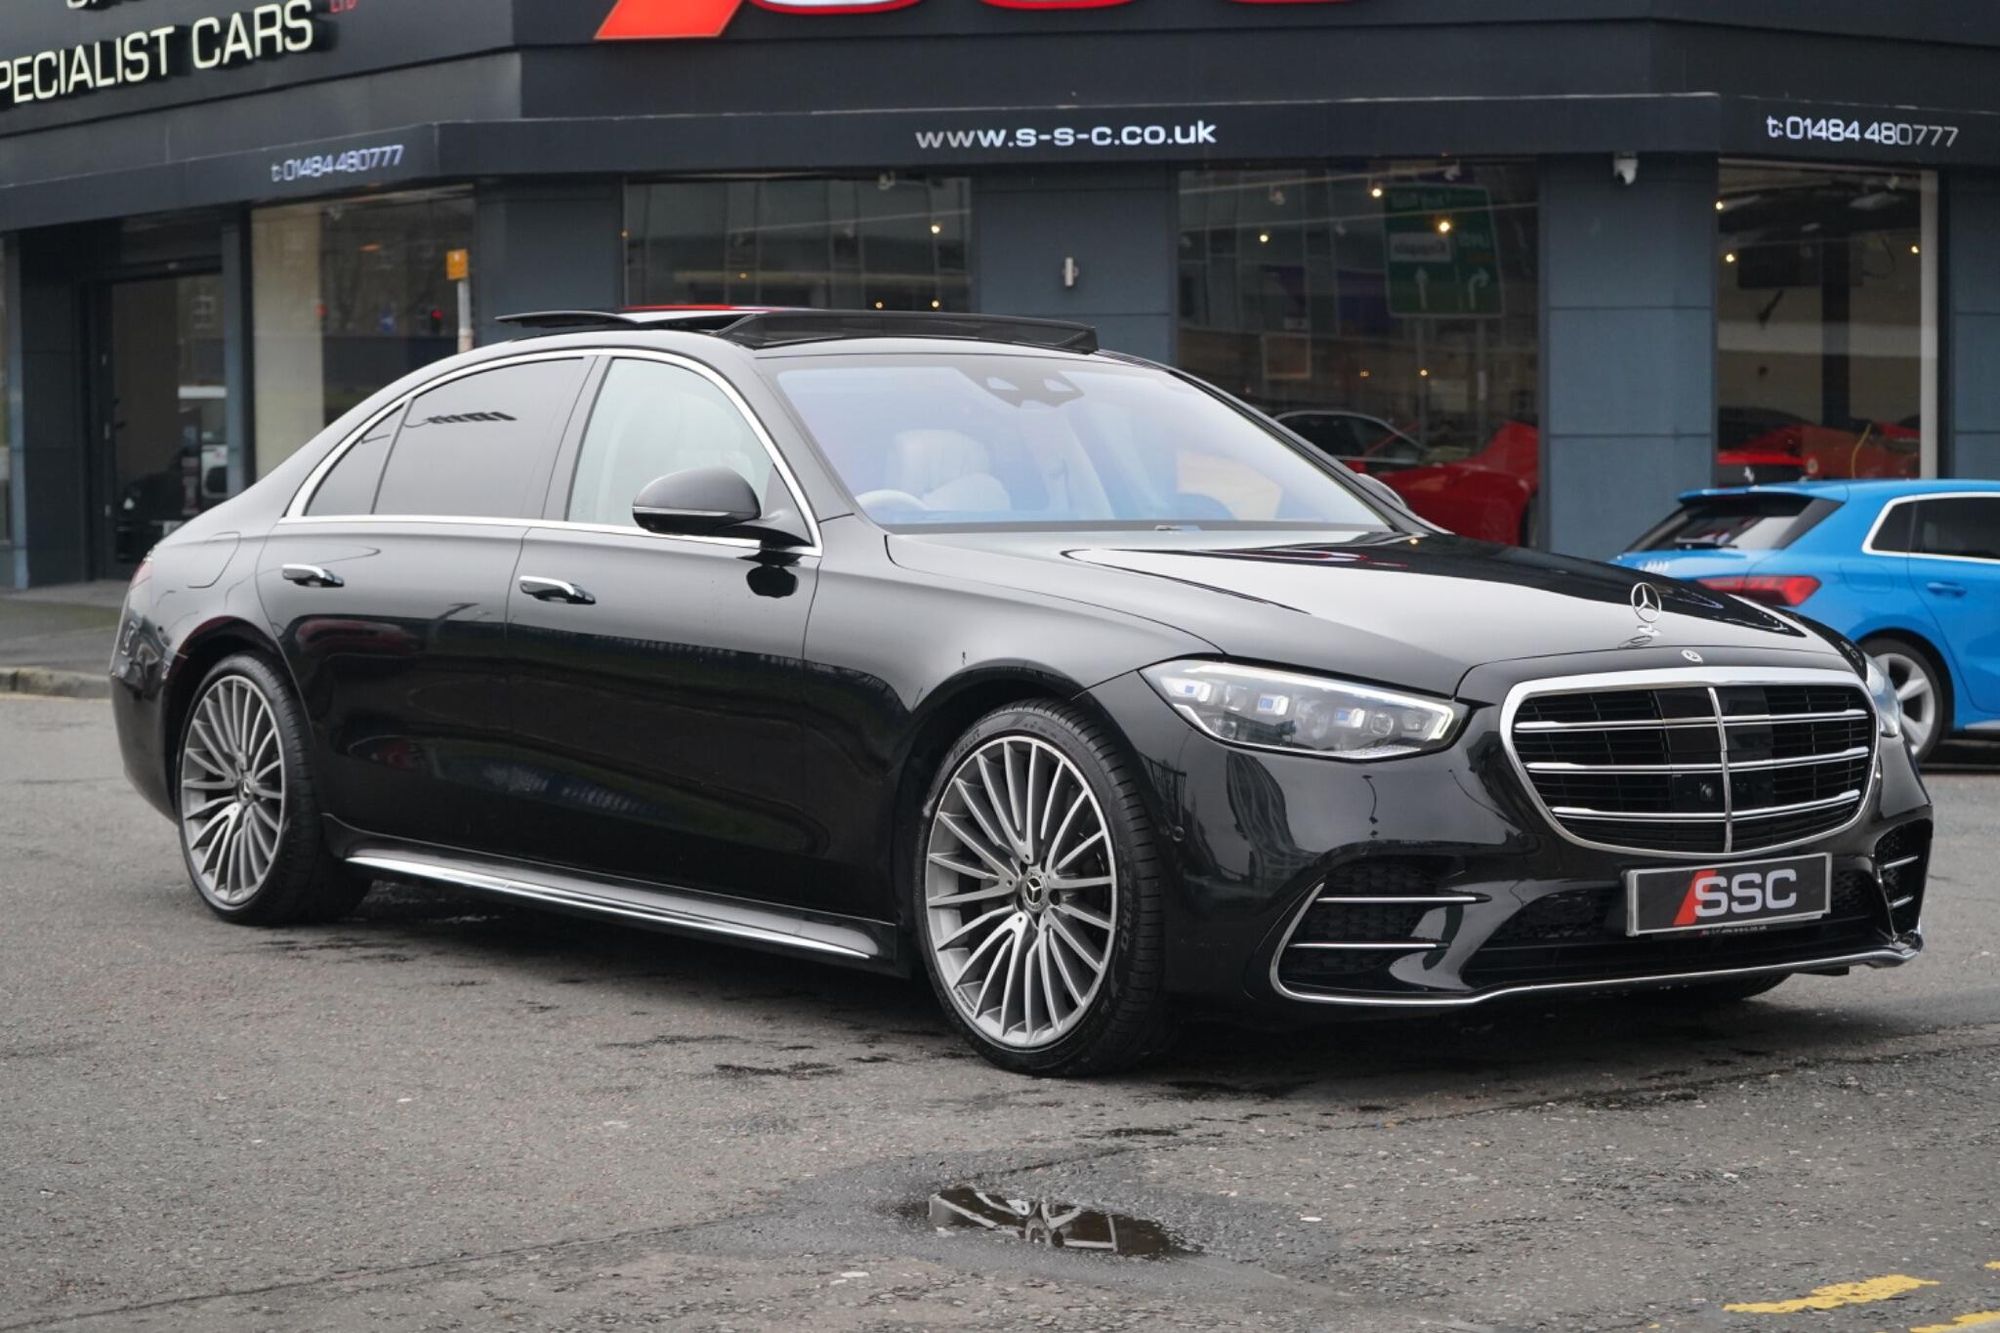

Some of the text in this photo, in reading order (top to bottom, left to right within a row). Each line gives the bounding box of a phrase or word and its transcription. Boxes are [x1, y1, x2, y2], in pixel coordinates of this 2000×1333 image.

[192, 0, 313, 69] CARS
[915, 120, 1217, 149] www.s-s-c.co.uk
[1864, 122, 1959, 147] 480777
[335, 144, 404, 172] 480777
[1695, 868, 1796, 917] SSC
